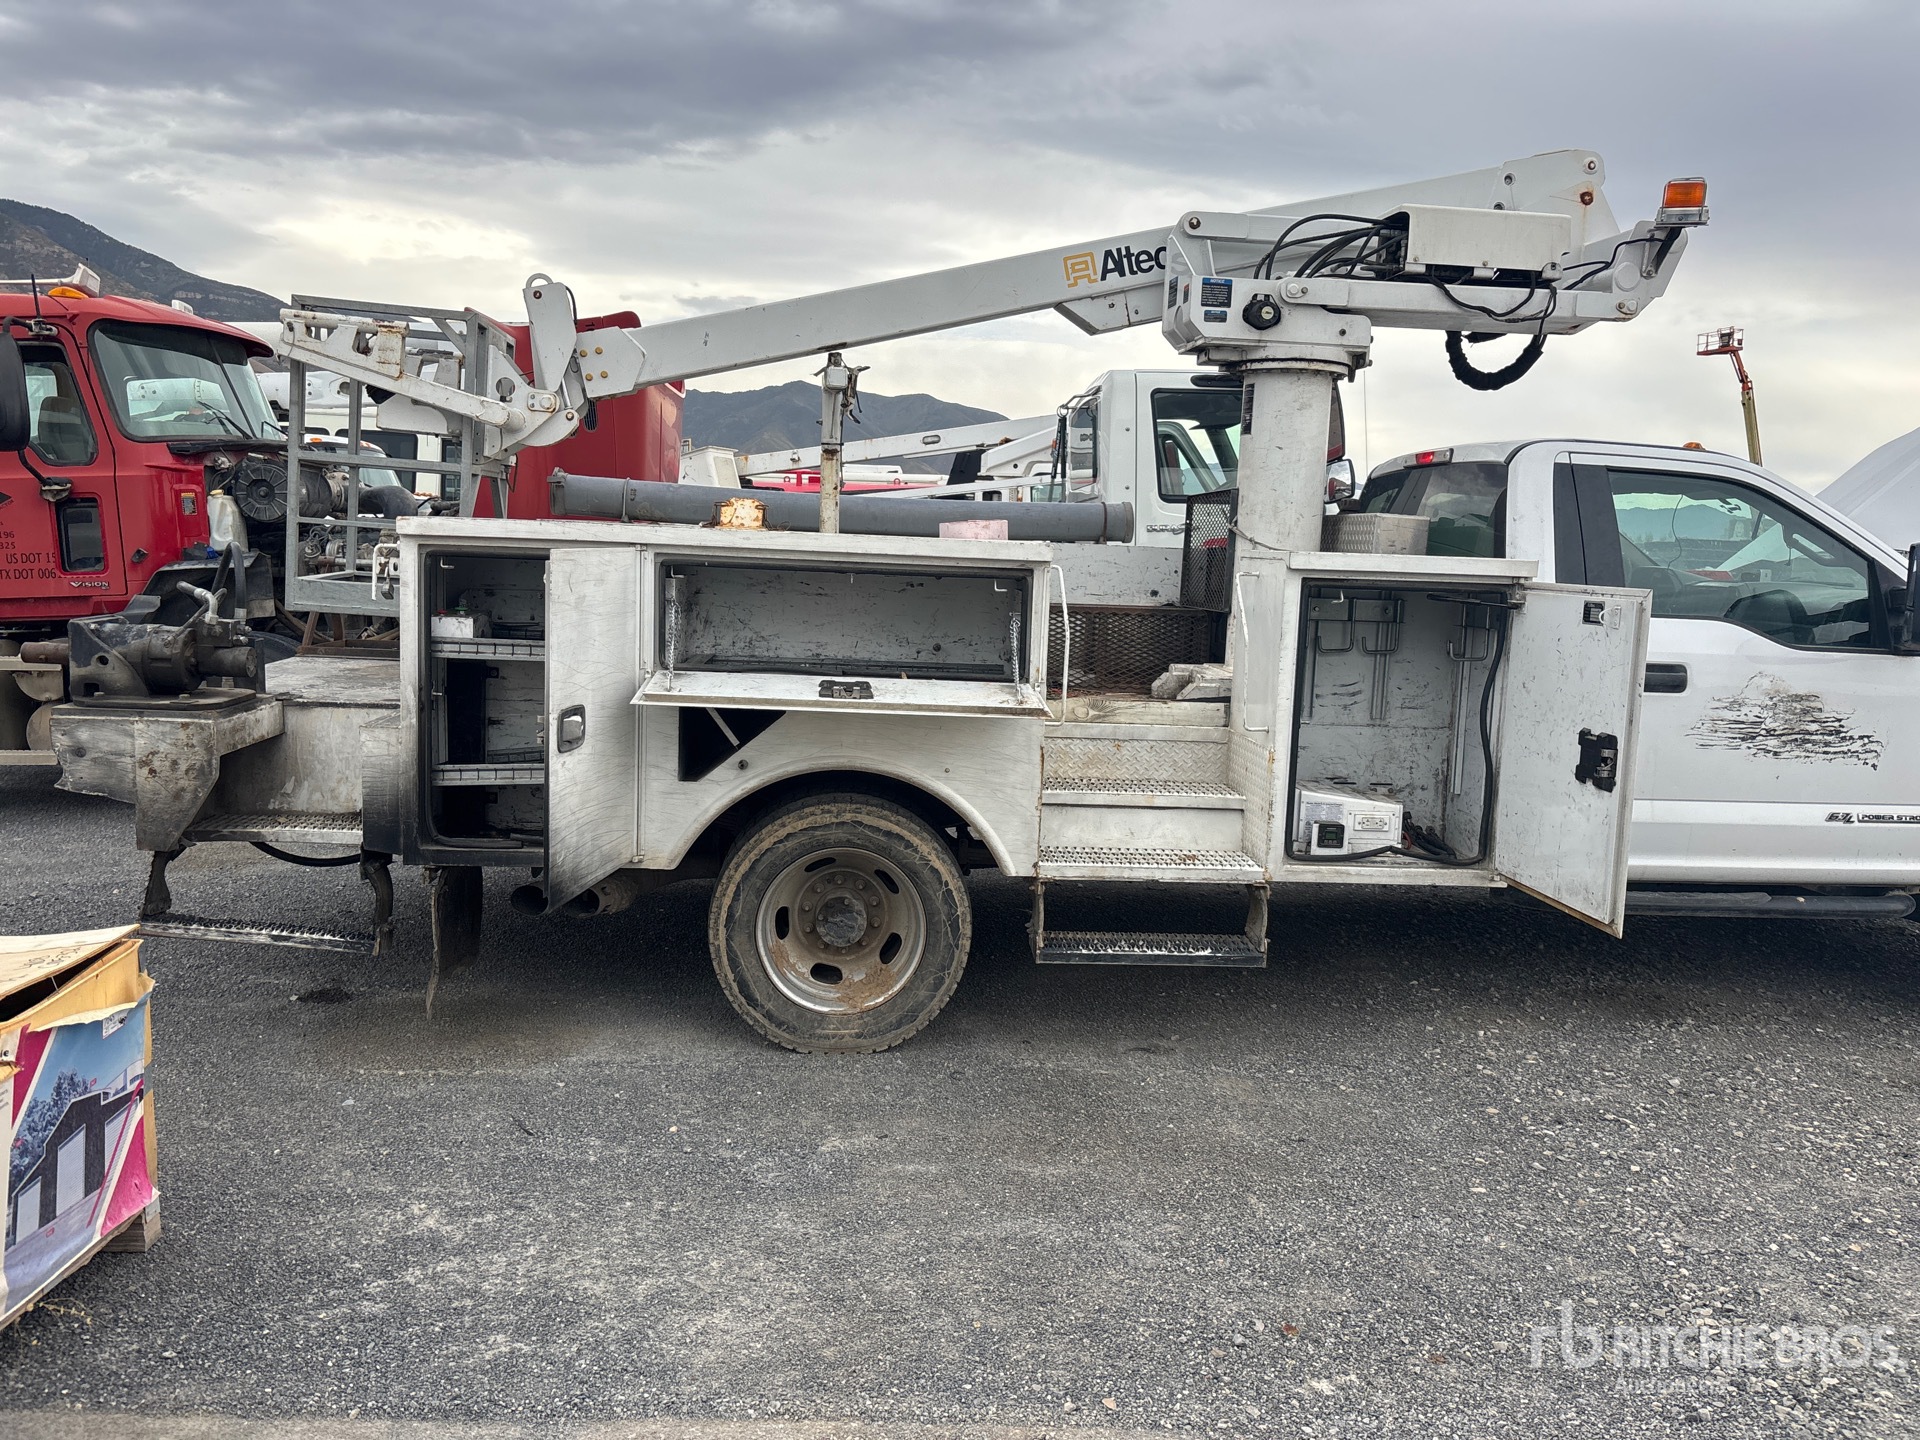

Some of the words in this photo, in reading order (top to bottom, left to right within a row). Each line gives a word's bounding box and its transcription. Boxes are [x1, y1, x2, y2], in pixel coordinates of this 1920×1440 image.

[1100, 246, 1167, 282] Altec
[6, 553, 19, 564] US
[21, 552, 42, 564] DOT
[0, 569, 11, 580] TX
[14, 569, 35, 580] DOT
